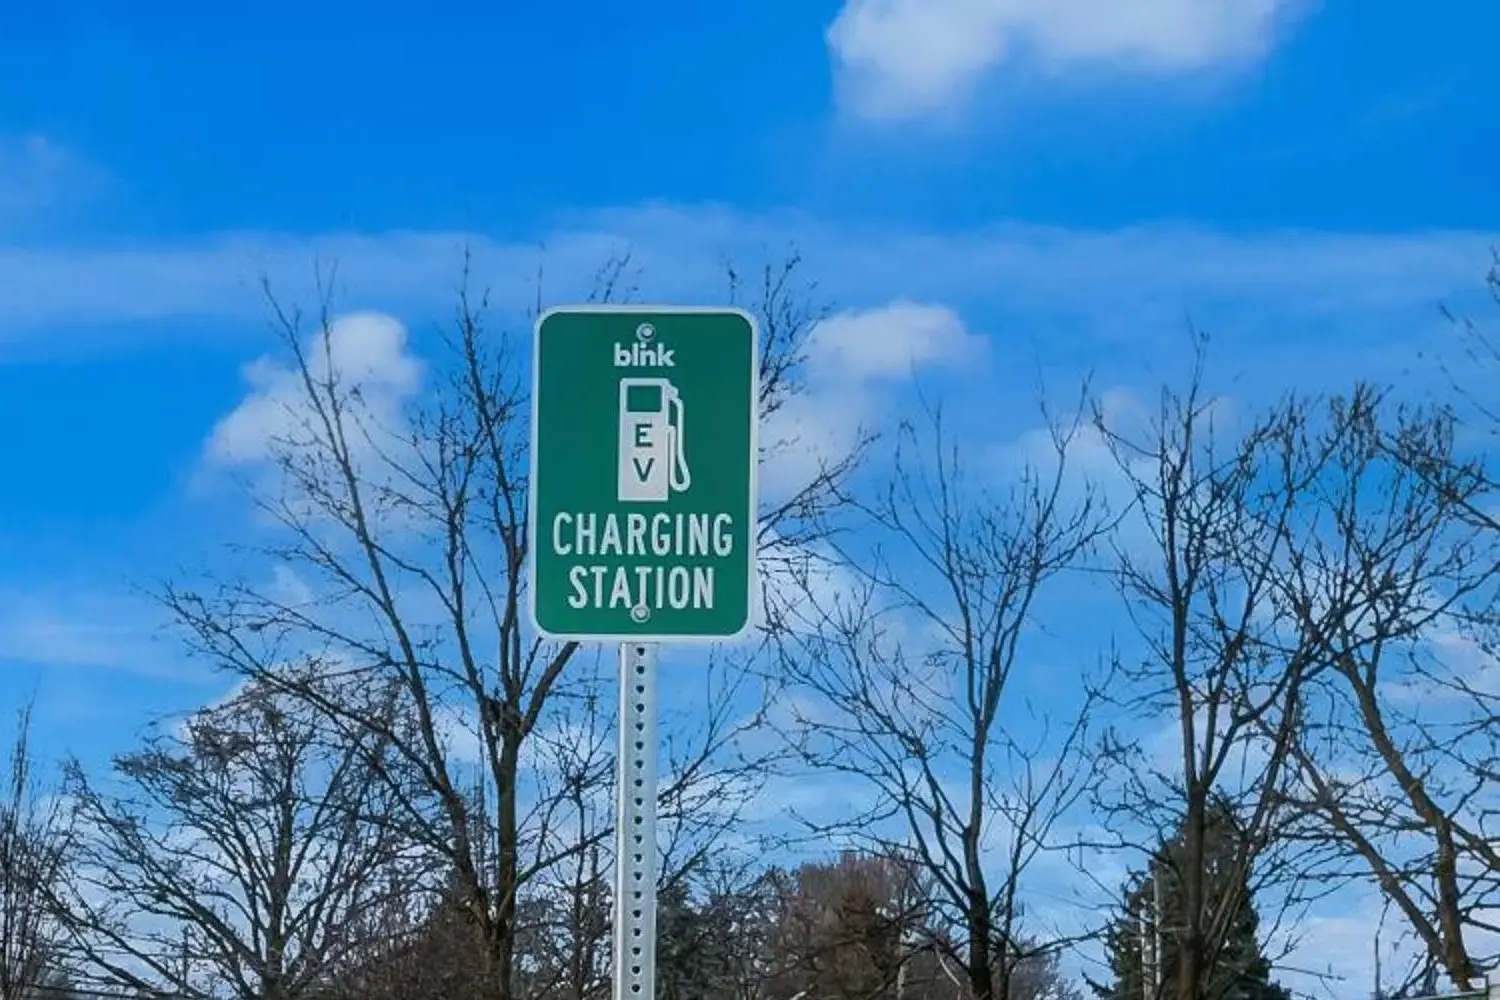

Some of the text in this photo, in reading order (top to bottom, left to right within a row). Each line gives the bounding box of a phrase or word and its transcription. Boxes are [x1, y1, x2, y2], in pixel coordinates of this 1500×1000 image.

[613, 342, 676, 367] blink
[553, 512, 733, 557] CHARGING
[568, 565, 714, 609] STATION
